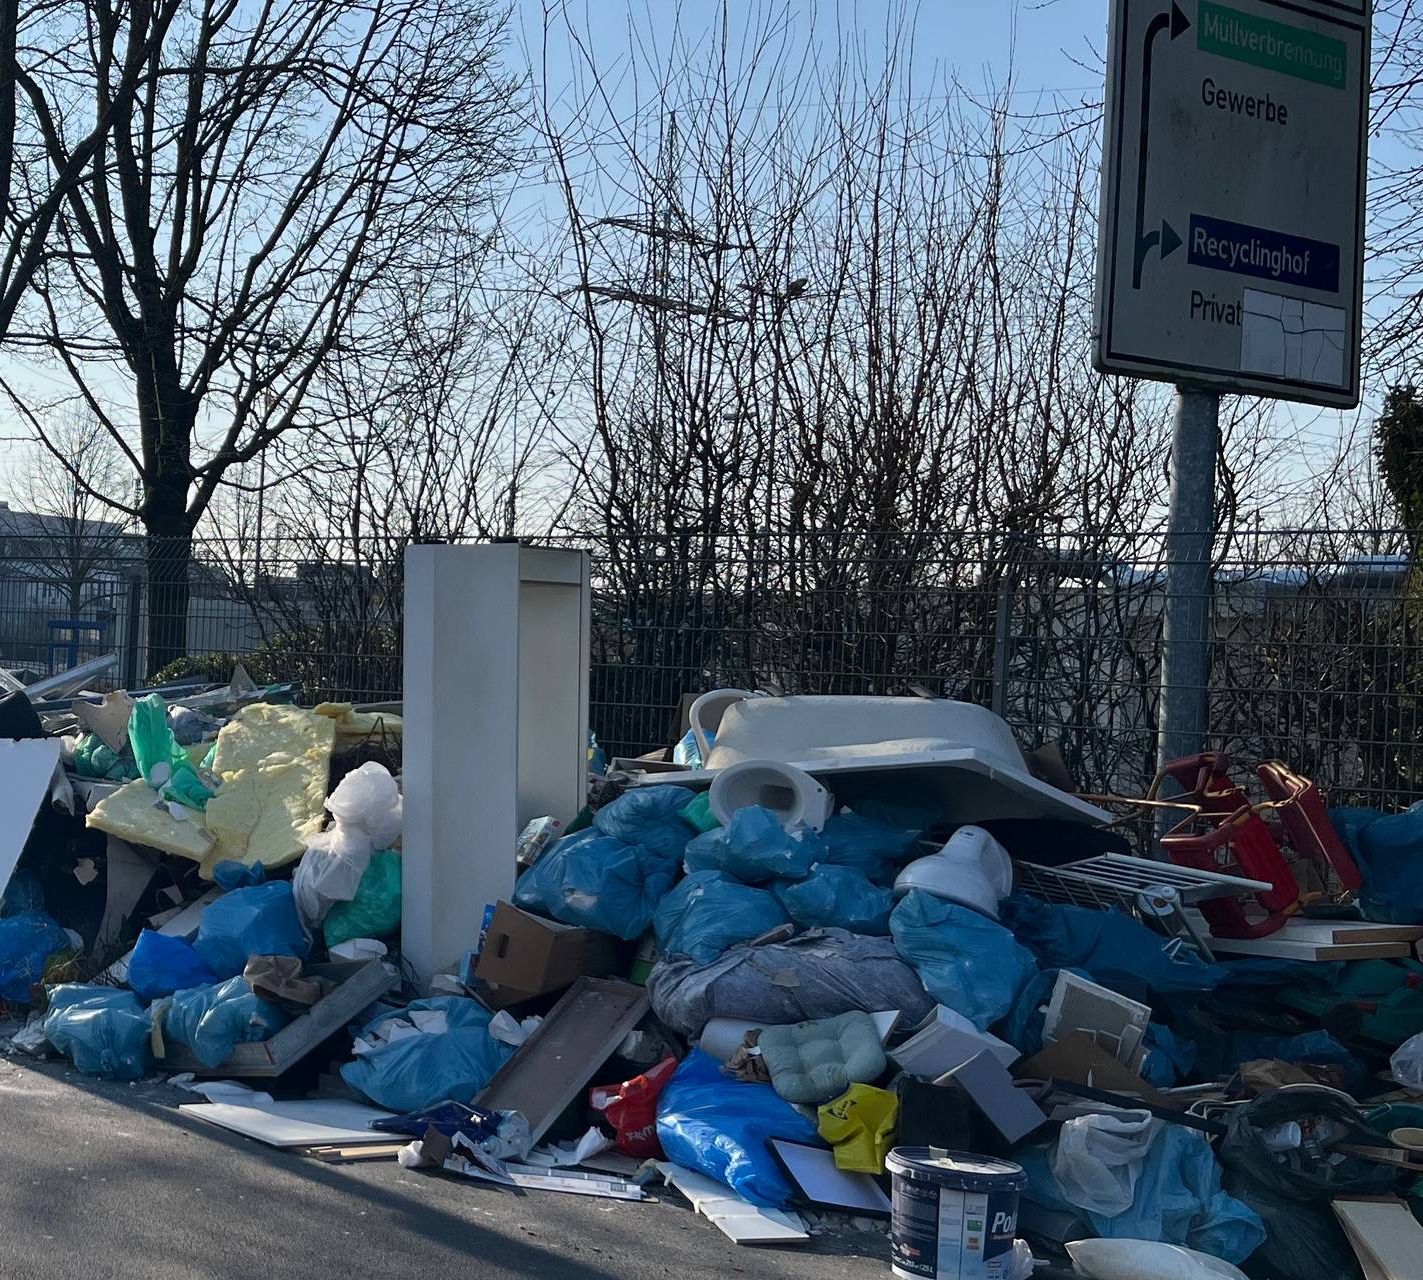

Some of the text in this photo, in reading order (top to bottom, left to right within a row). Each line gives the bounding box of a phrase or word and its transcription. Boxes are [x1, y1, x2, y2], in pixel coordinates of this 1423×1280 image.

[1204, 11, 1343, 81] Müllverbrennung
[1201, 77, 1288, 126] Gewerbe
[1193, 226, 1310, 277] Recyclinghof
[1190, 289, 1243, 327] Privat
